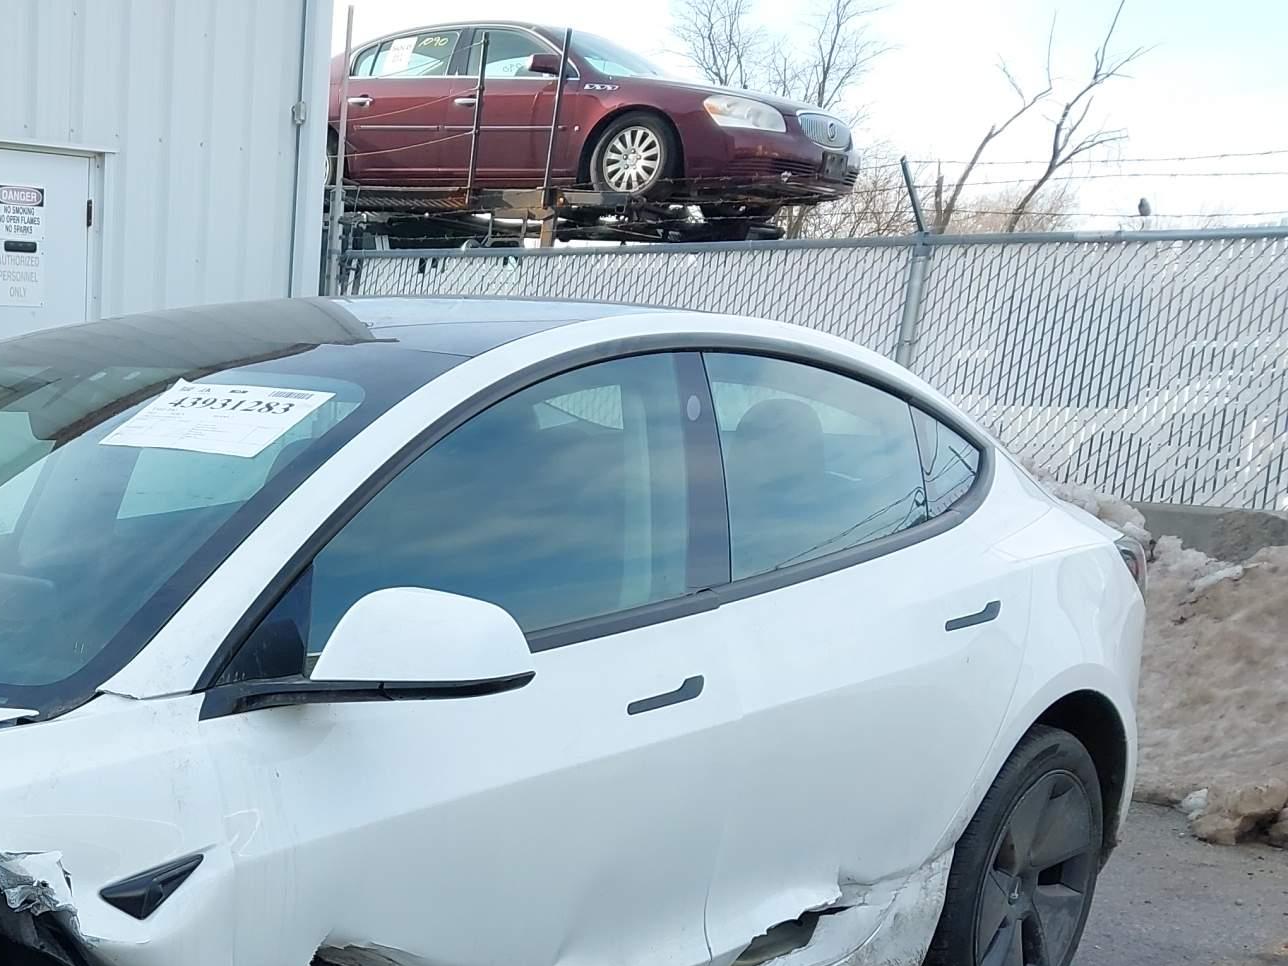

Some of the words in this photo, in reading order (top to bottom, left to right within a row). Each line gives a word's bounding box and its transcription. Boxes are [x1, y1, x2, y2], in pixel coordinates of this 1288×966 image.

[1, 189, 37, 202] DANGER
[3, 206, 11, 214] NO
[12, 206, 35, 216] SMOKING
[6, 215, 20, 224] OPEN
[21, 216, 40, 225] FLAMES
[5, 225, 12, 233] NO
[14, 225, 33, 234] SPARKS
[9, 286, 27, 298] ONLY
[169, 396, 295, 414] 43931283
